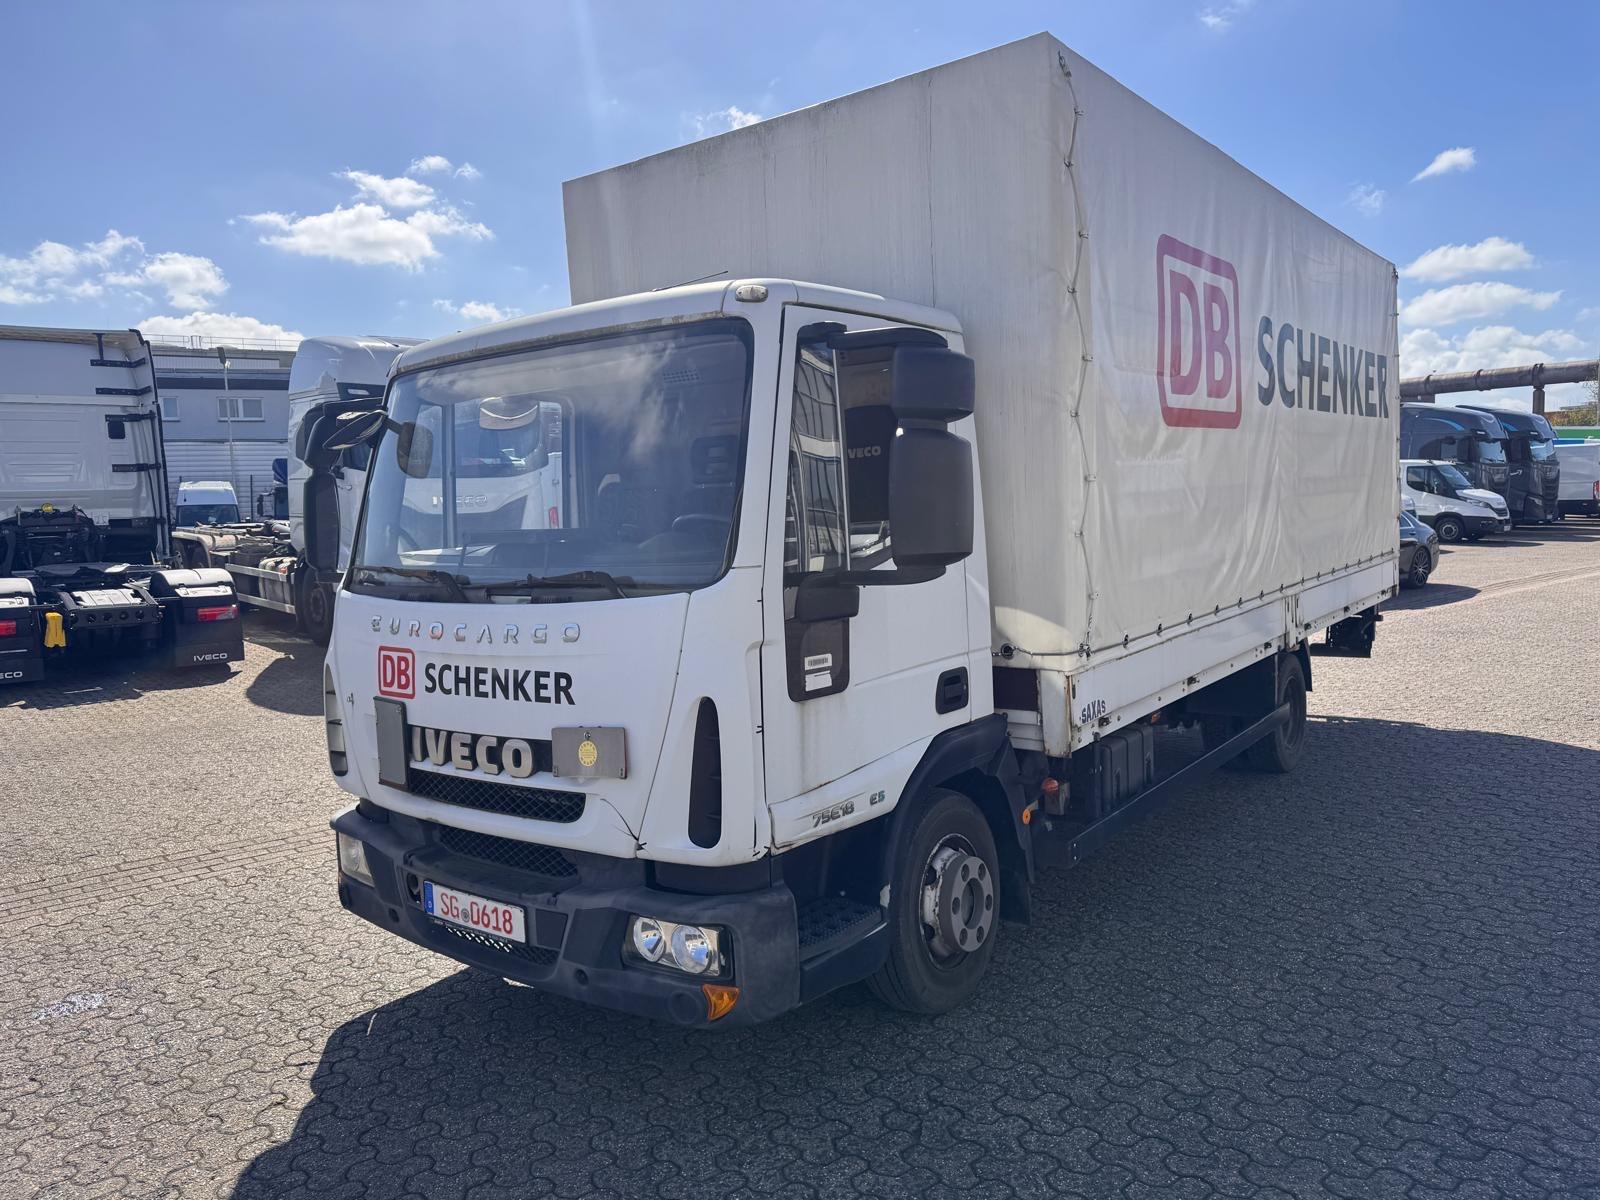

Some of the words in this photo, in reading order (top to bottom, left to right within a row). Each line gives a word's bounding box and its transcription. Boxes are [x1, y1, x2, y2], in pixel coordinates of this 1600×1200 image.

[1169, 269, 1233, 399] DB
[1257, 315, 1389, 418] SCHENKER
[371, 615, 581, 644] EUROCARGO
[193, 652, 228, 662] IVECO
[382, 654, 412, 690] DB
[424, 662, 576, 706] SCHENKER
[1081, 699, 1106, 724] SAXAS
[411, 726, 534, 779] IVECO
[812, 800, 855, 828] 75E18
[869, 790, 886, 806] E5
[440, 892, 460, 919] SG
[470, 901, 513, 935] 0618
